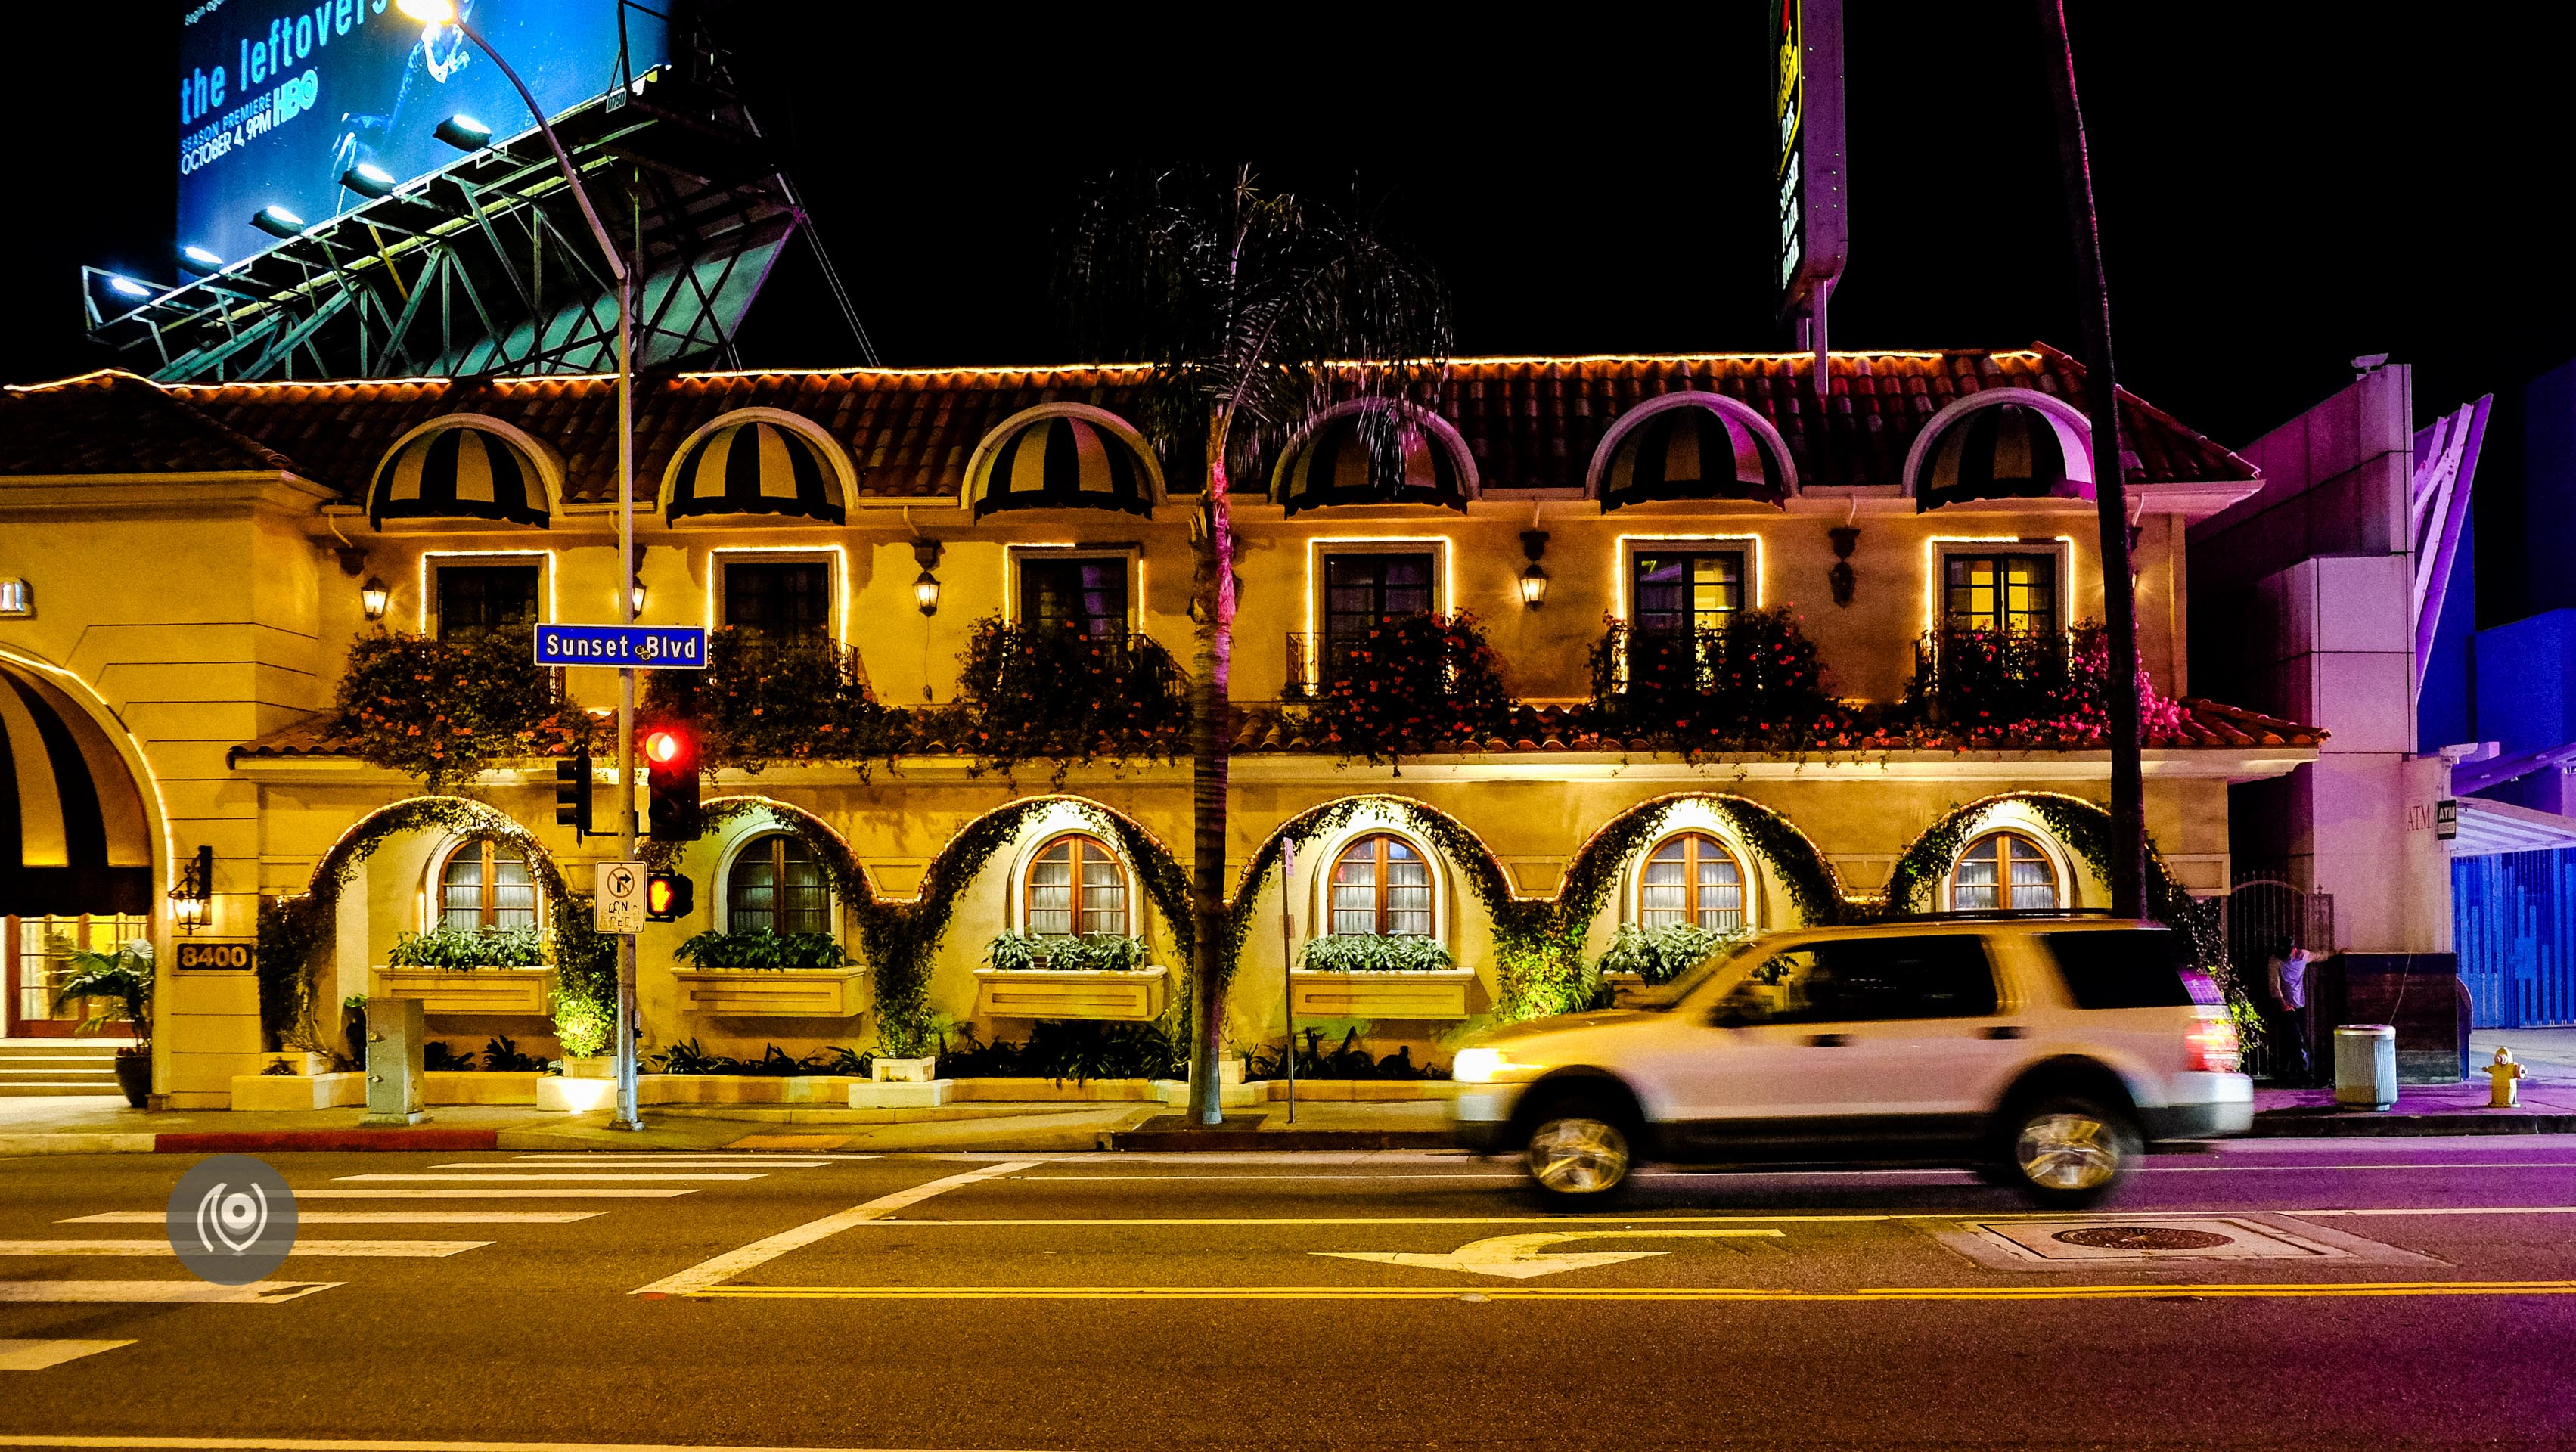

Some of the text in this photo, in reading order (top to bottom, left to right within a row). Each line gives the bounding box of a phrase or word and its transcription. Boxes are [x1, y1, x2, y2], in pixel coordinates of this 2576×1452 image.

[182, 66, 225, 125] the
[273, 69, 318, 127] HBO
[181, 131, 231, 175] OCTOBER
[246, 109, 272, 141] 9PM
[182, 92, 272, 154] SEASON PREMIERE
[546, 634, 696, 658] Sunset Blvd
[2407, 805, 2431, 831] ATM
[2438, 806, 2455, 821] ATM
[182, 946, 247, 966] 8400
